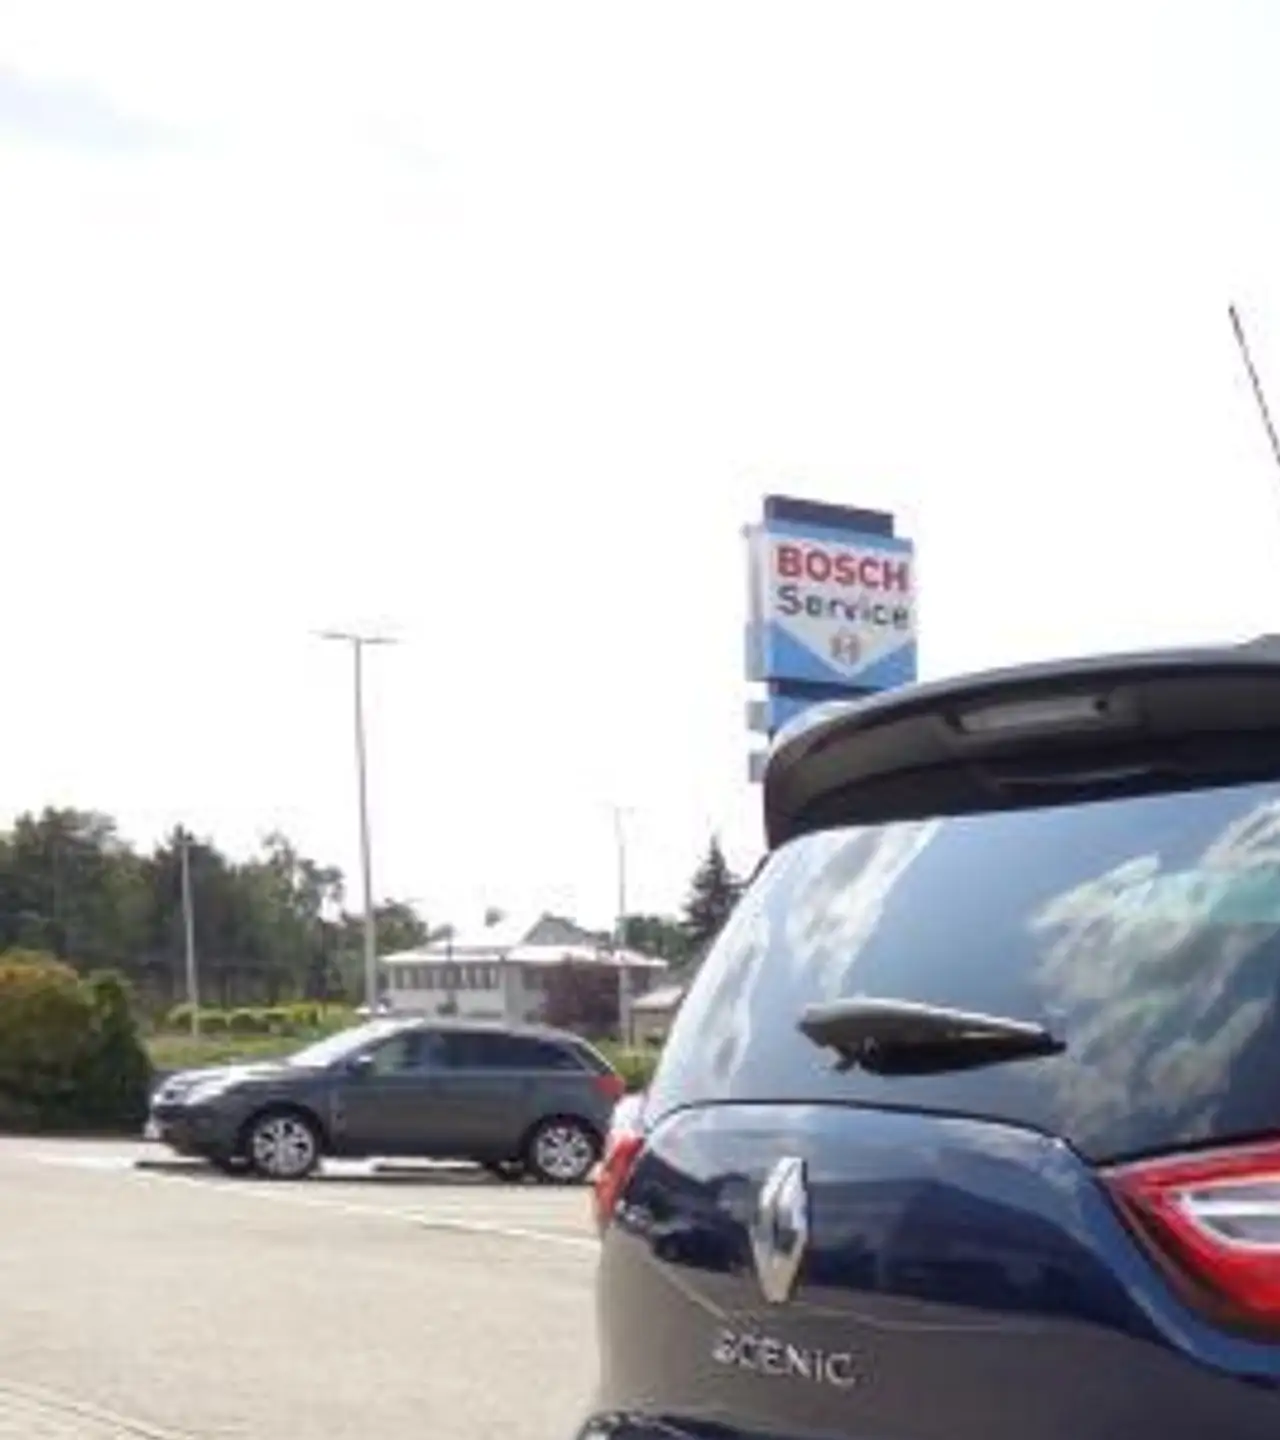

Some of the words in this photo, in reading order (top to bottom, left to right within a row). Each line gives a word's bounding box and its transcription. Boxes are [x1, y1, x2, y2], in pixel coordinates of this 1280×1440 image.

[777, 547, 909, 591] BOSCH
[777, 585, 909, 629] Service
[712, 1331, 856, 1387] SCENIC
